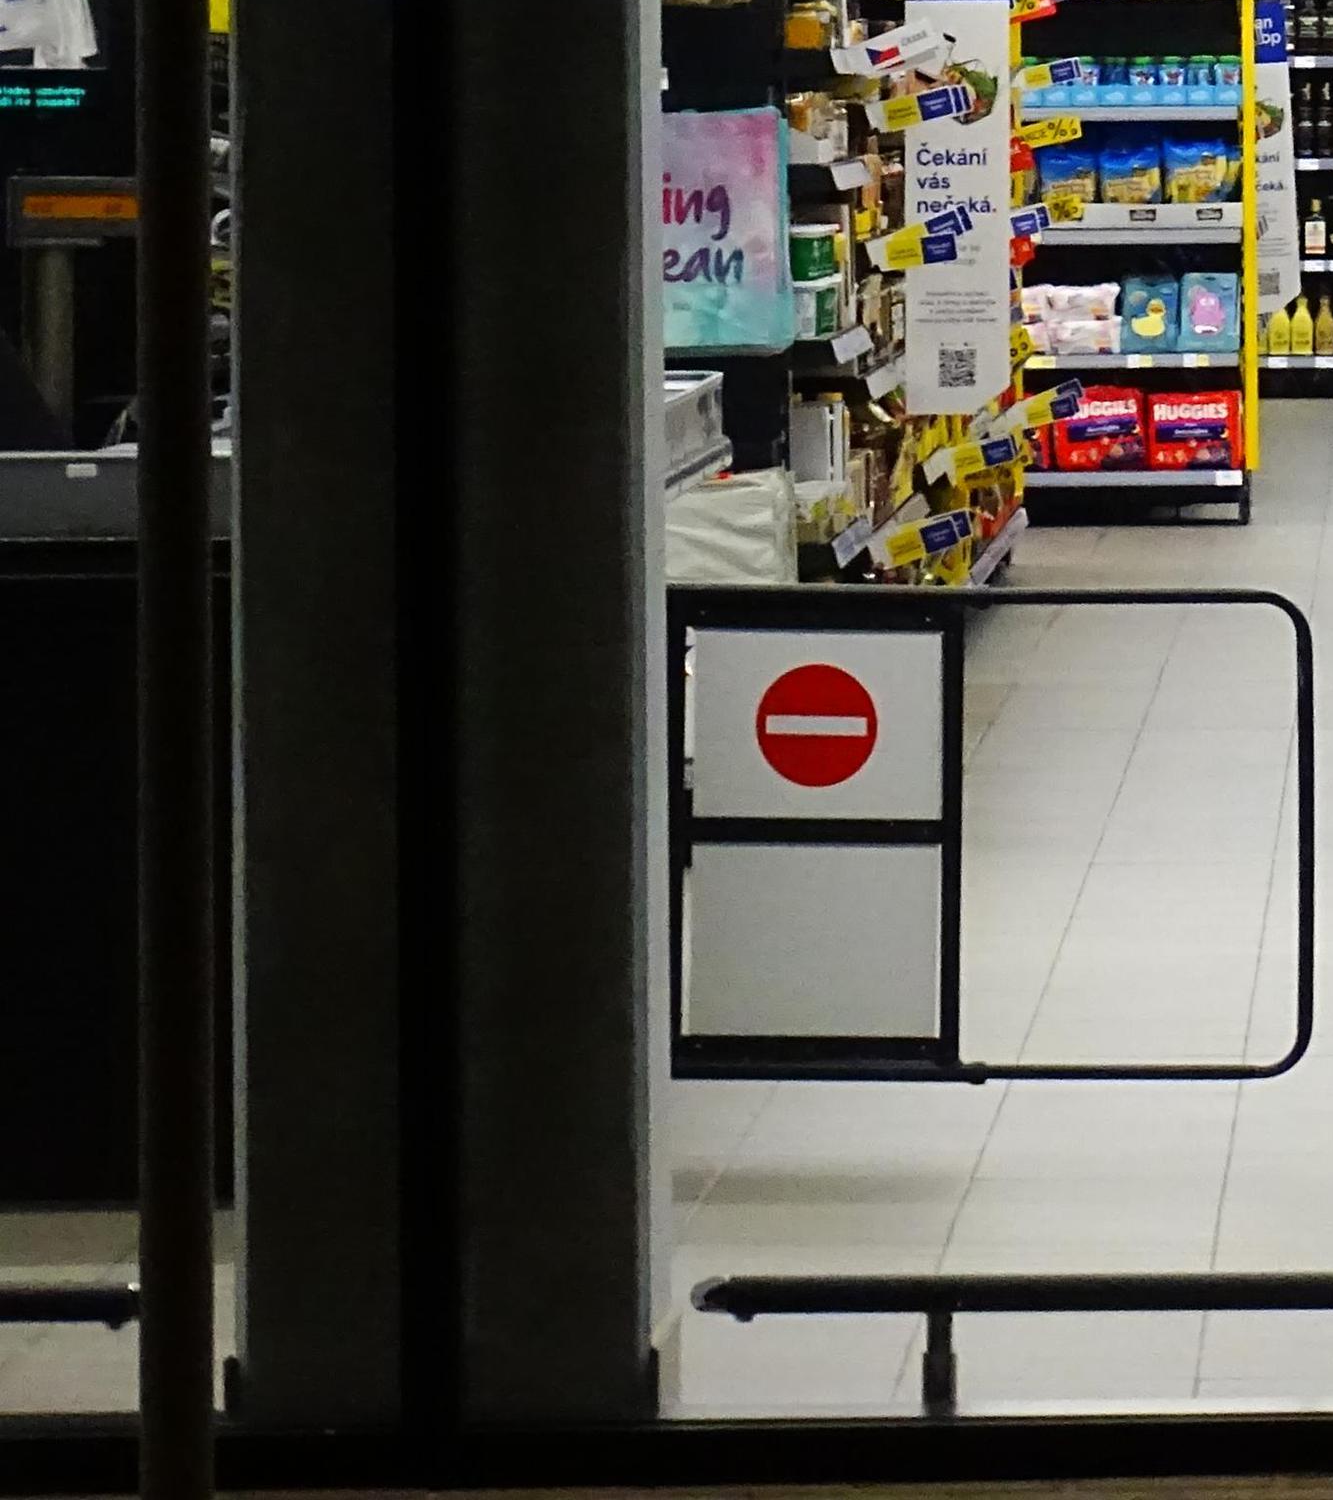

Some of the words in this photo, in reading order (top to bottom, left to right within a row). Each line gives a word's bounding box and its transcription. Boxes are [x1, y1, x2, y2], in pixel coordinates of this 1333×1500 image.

[916, 142, 987, 167] Čekání
[916, 172, 951, 190] vás
[916, 195, 997, 213] nečká.
[1074, 399, 1138, 420] UGGIES
[1153, 403, 1228, 422] HUGGIES
